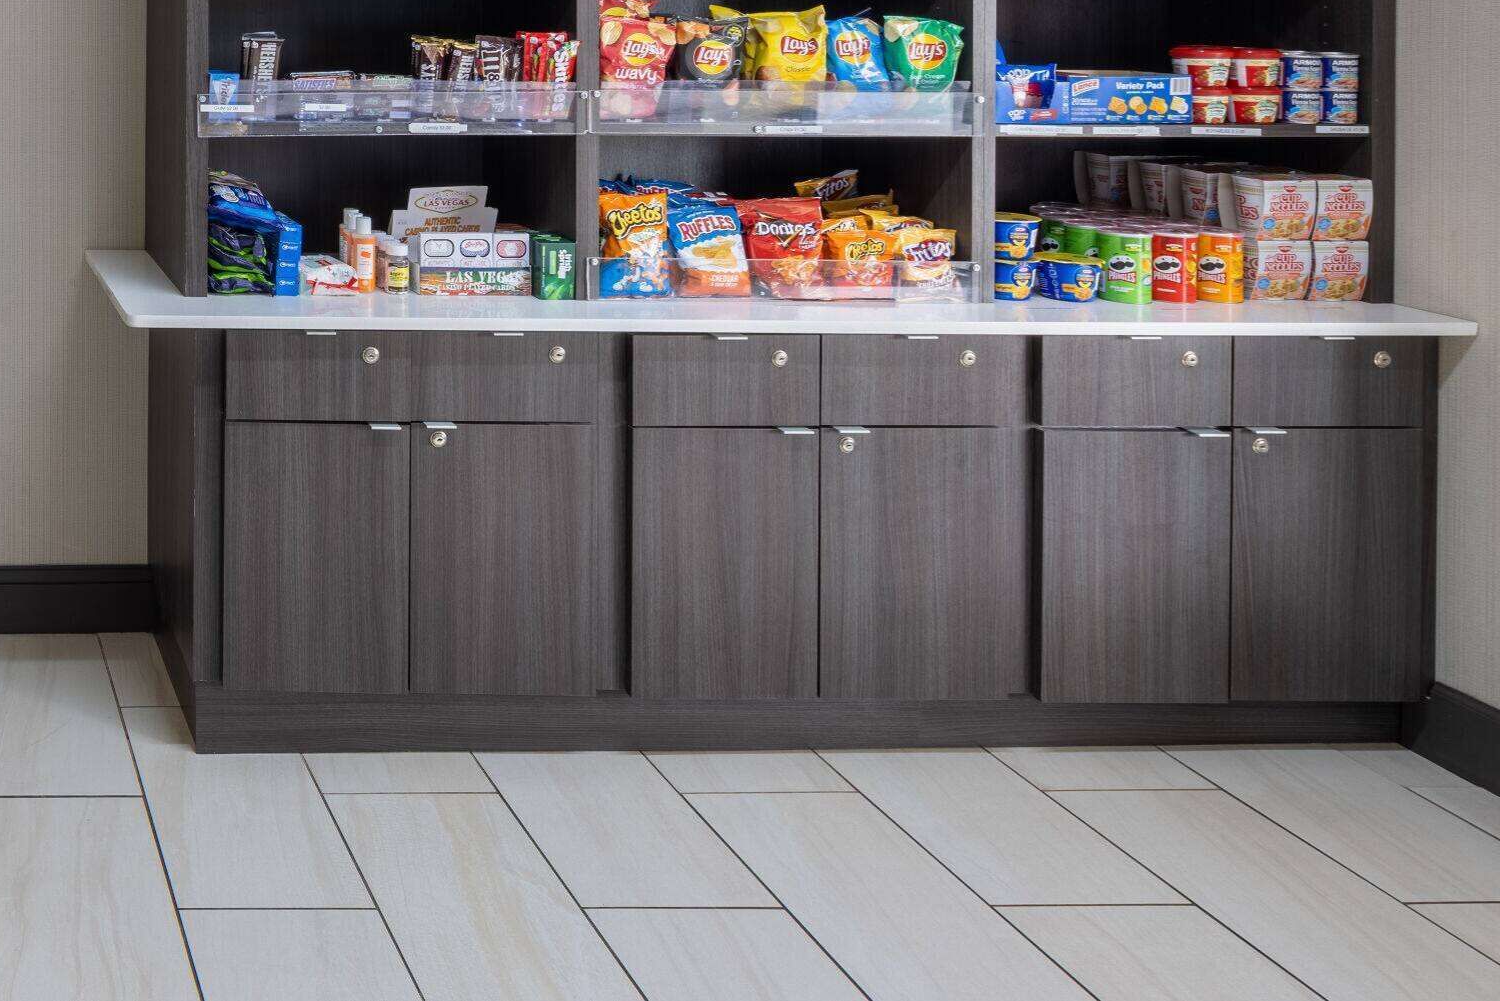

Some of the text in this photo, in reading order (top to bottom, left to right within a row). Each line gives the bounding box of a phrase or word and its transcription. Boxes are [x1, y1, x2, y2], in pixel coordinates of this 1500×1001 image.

[784, 37, 818, 55] Lay's
[837, 37, 871, 57] Lay's
[909, 41, 947, 61] Lay's
[696, 47, 730, 66] Lay's
[616, 68, 658, 84] wavy
[1073, 81, 1099, 94] Lance
[1116, 82, 1164, 91] Variety Pack
[1281, 194, 1300, 202] CUP
[1337, 193, 1356, 201] CUP
[1270, 201, 1308, 212] NOODLES
[1325, 201, 1365, 211] NOODLES
[424, 217, 462, 226] AUTHENTIC
[608, 205, 663, 239] Cheetos
[678, 216, 737, 242] RUFFLES
[755, 220, 817, 236] Doritos
[848, 240, 885, 260] Cheetos
[903, 241, 952, 262] Fritos
[1277, 254, 1296, 262] CUP
[1334, 254, 1353, 263] CUP
[1265, 261, 1304, 272] NOODLES
[1323, 262, 1361, 272] NOODLES
[446, 271, 473, 284] LAS
[1108, 272, 1136, 283] PRINGLES
[1153, 272, 1181, 283] PRINGLES
[1198, 273, 1226, 284] PRINGLES
